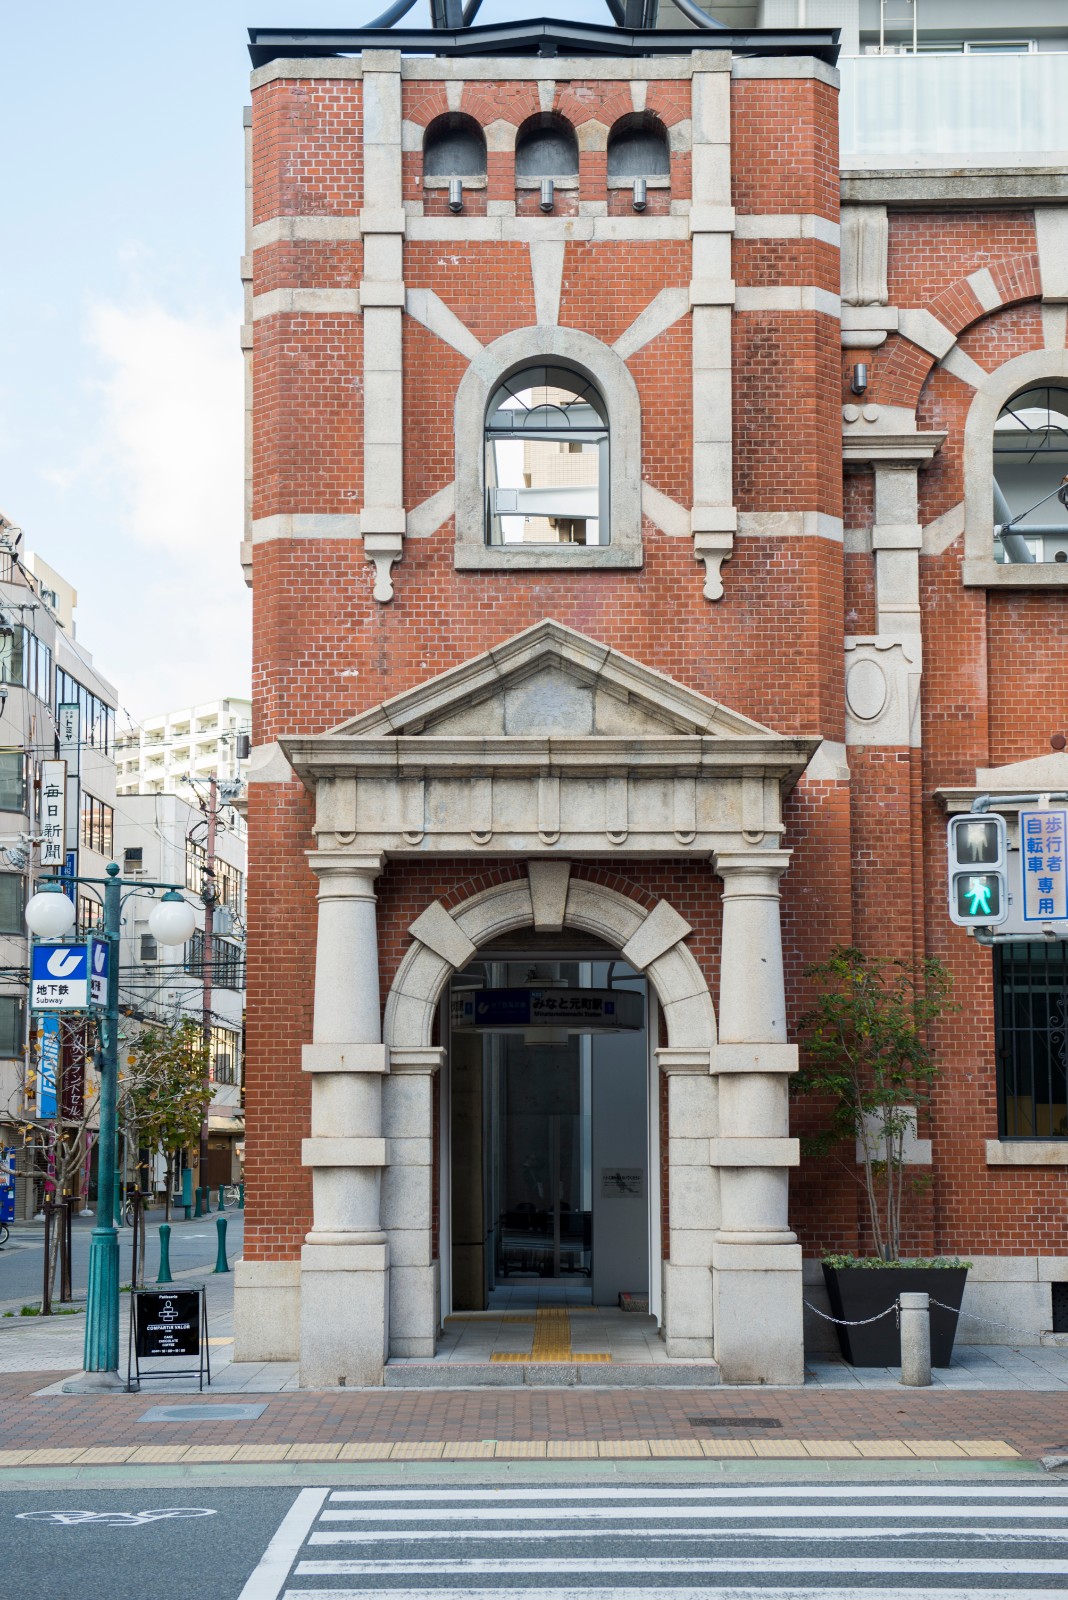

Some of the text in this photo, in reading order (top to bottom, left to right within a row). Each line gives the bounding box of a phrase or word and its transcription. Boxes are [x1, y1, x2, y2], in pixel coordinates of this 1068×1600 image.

[44, 784, 63, 859] 毎日新聞
[1026, 817, 1044, 873] 自転車
[1045, 816, 1063, 873] 歩行者
[1037, 877, 1055, 915] 専用
[36, 984, 69, 996] 地下鉄
[36, 997, 63, 1005] Subway
[533, 997, 603, 1010] みなと元町駅
